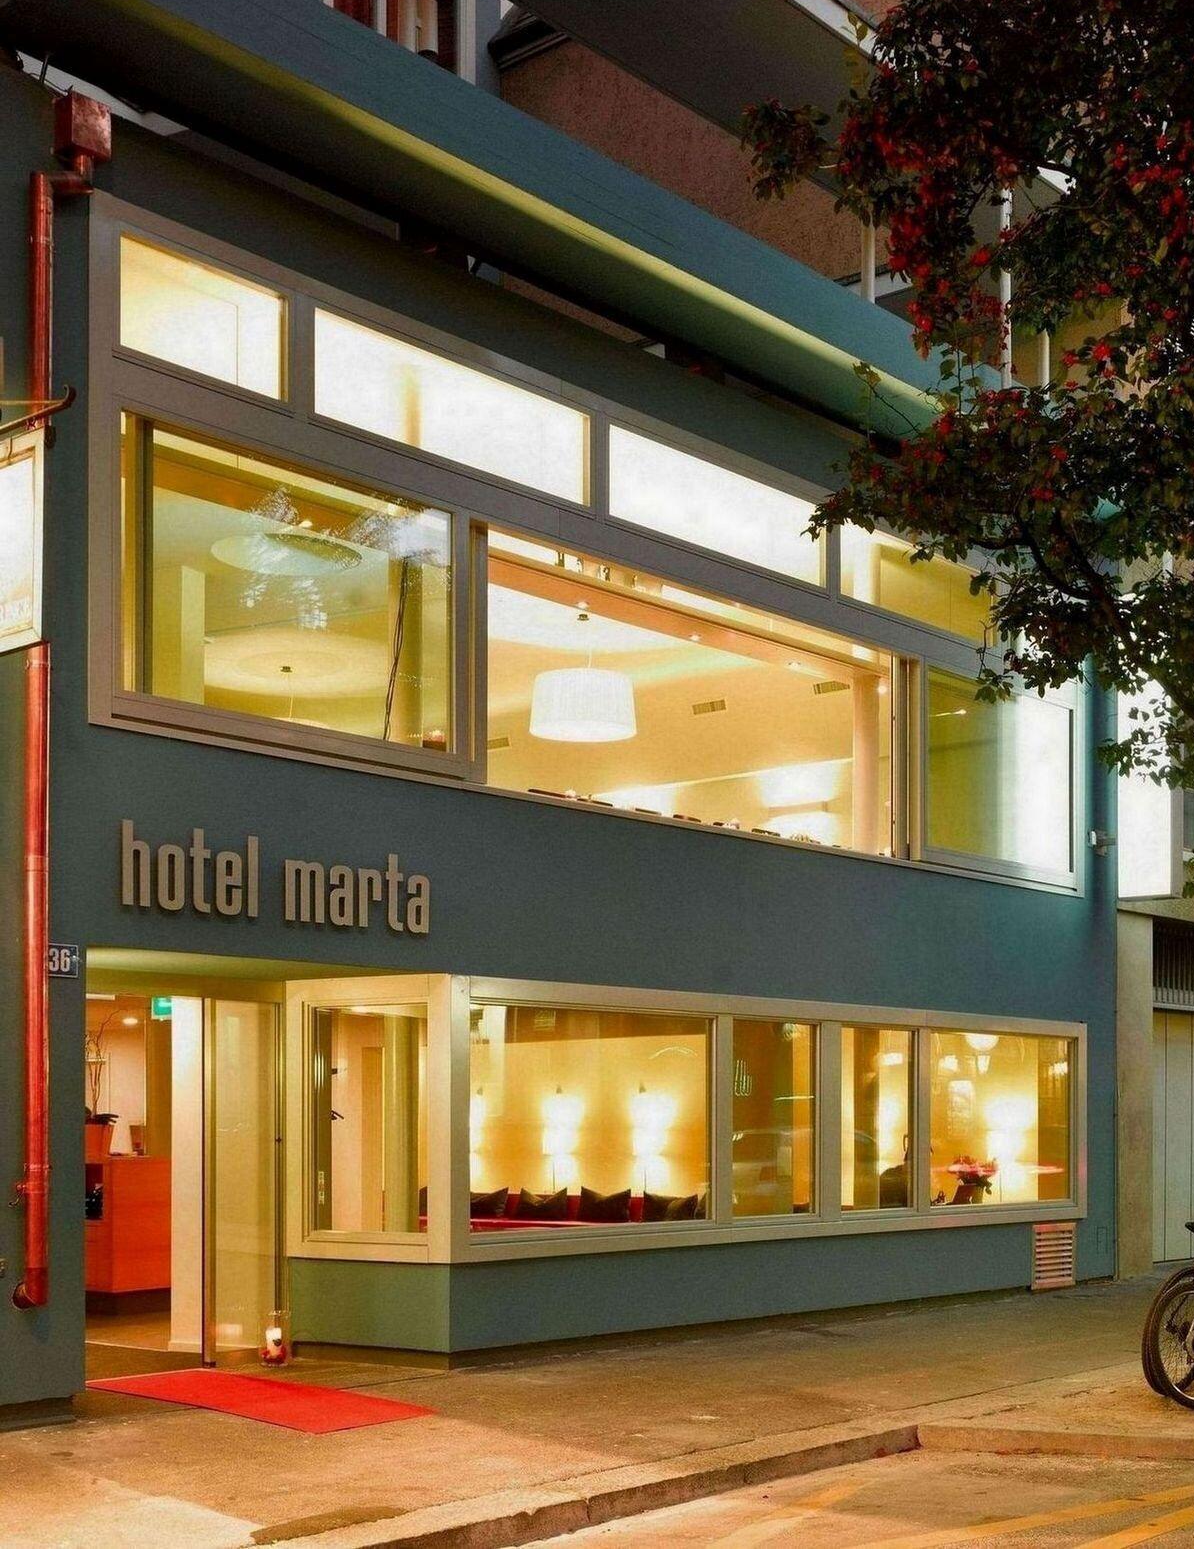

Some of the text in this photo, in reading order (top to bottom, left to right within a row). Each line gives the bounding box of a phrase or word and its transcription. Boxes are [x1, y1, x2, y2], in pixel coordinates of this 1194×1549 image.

[121, 818, 431, 936] hotel marta
[48, 948, 71, 973] 36
